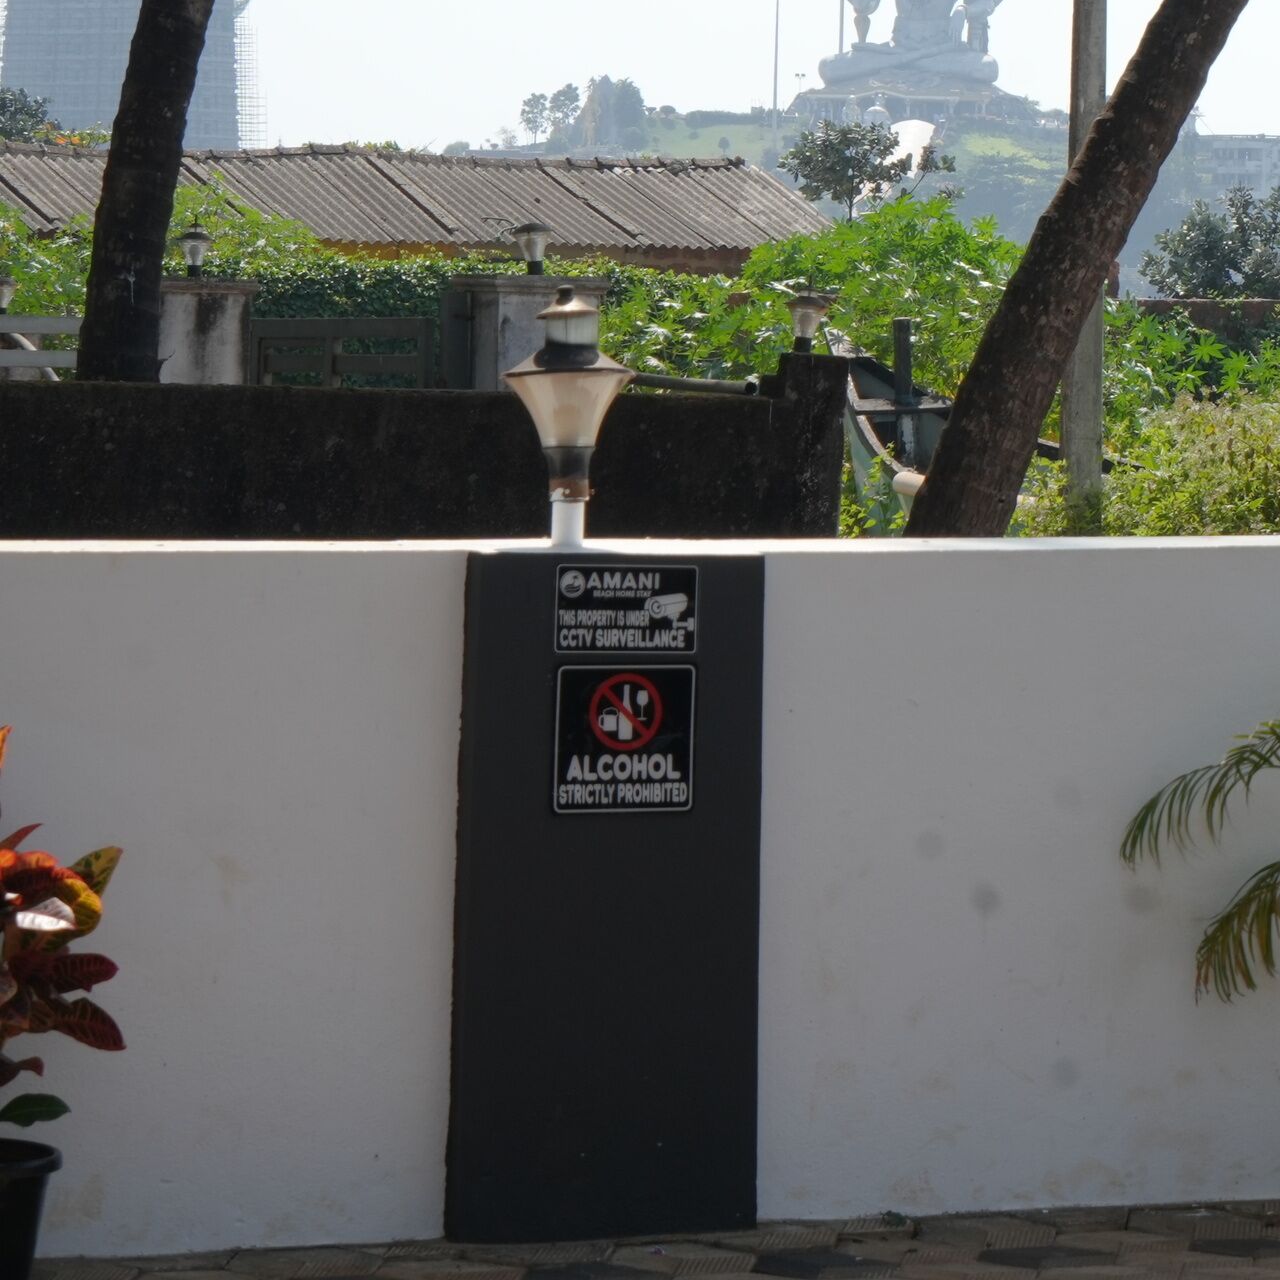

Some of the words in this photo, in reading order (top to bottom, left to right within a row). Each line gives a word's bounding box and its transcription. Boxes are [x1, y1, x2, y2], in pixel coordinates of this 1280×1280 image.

[586, 571, 661, 589] AMANI
[593, 590, 614, 598] BEACH
[559, 610, 576, 626] THIS
[577, 609, 616, 626] PROPERTY
[617, 609, 625, 626] IS
[625, 609, 650, 627] UNDER
[560, 630, 593, 648] CCTV
[595, 628, 686, 648] SURVEILLANCE
[566, 753, 681, 781] ALCOHOL
[558, 783, 615, 805] STRICTLY
[616, 782, 688, 804] PROHIBITED
